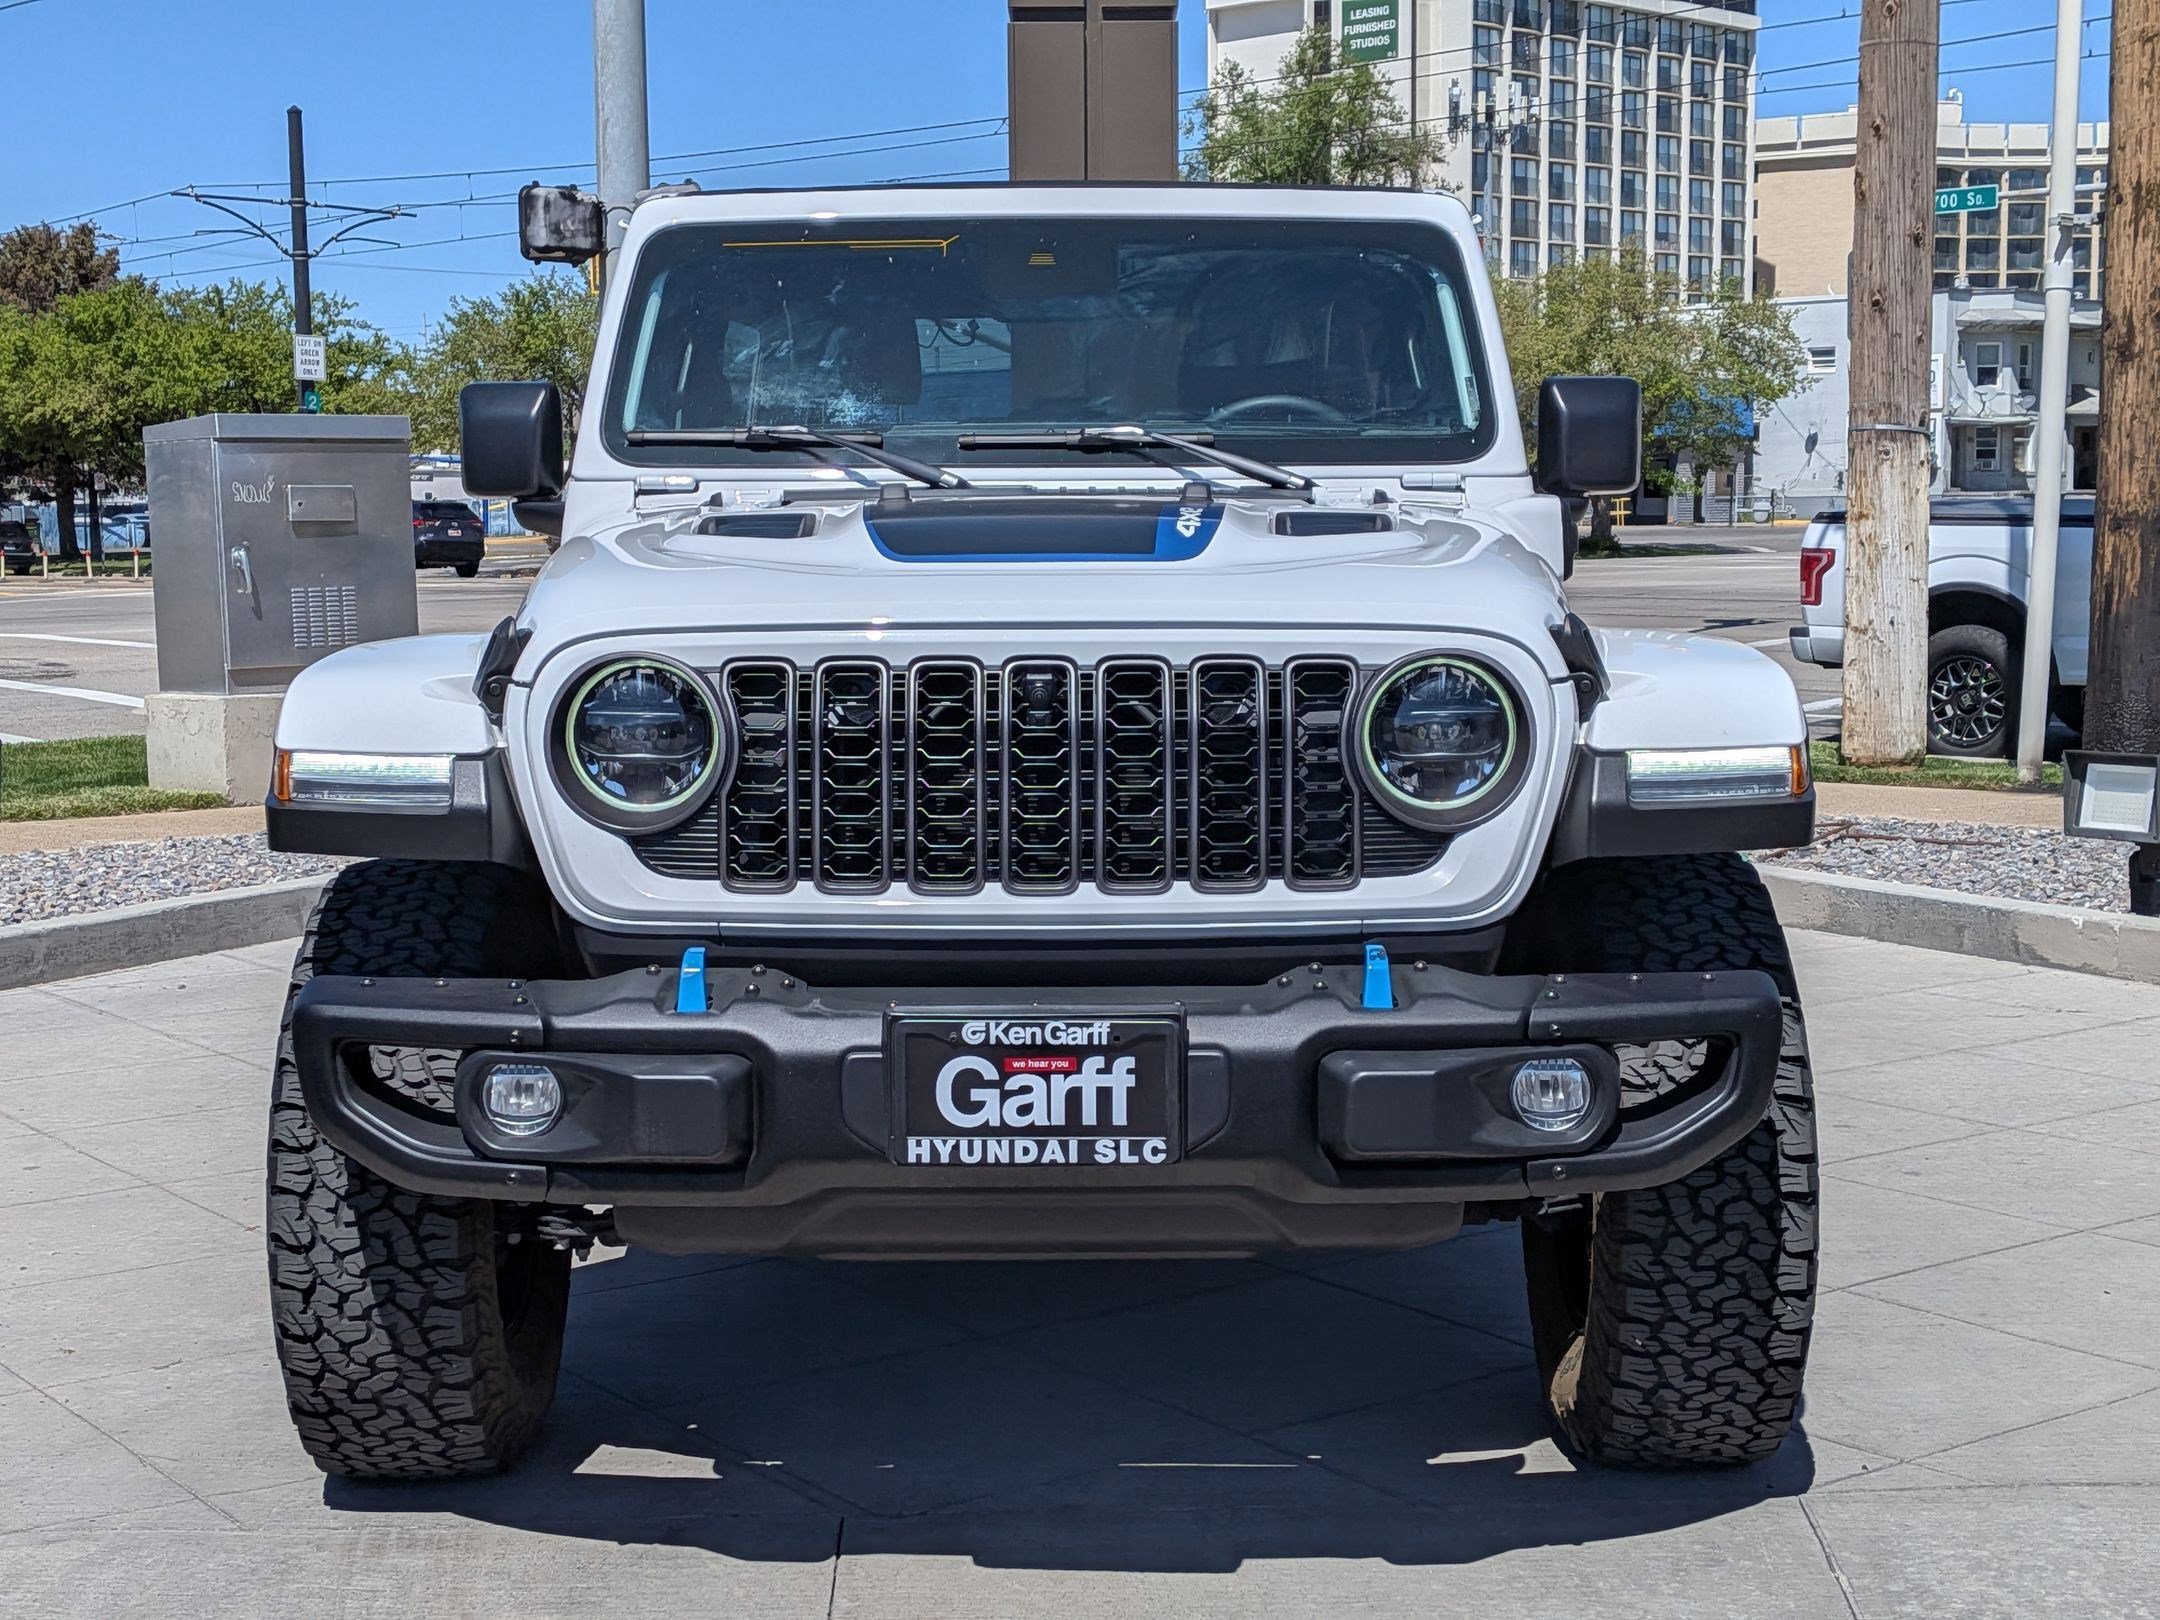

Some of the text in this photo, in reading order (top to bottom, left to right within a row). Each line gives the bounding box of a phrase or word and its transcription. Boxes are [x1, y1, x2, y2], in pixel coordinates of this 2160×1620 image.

[1350, 5, 1390, 20] LEASING
[1344, 19, 1396, 36] FURNISHED
[1350, 34, 1390, 50] STUDIOS
[297, 339, 311, 347] LEFT
[300, 348, 320, 357] GREEN
[308, 395, 318, 408] 2
[989, 1021, 1110, 1045] Ken Garff
[1028, 1059, 1049, 1068] hear
[1051, 1060, 1069, 1070] you
[935, 1055, 1136, 1128] Garff
[907, 1138, 1168, 1164] HYUNDAI SLC
